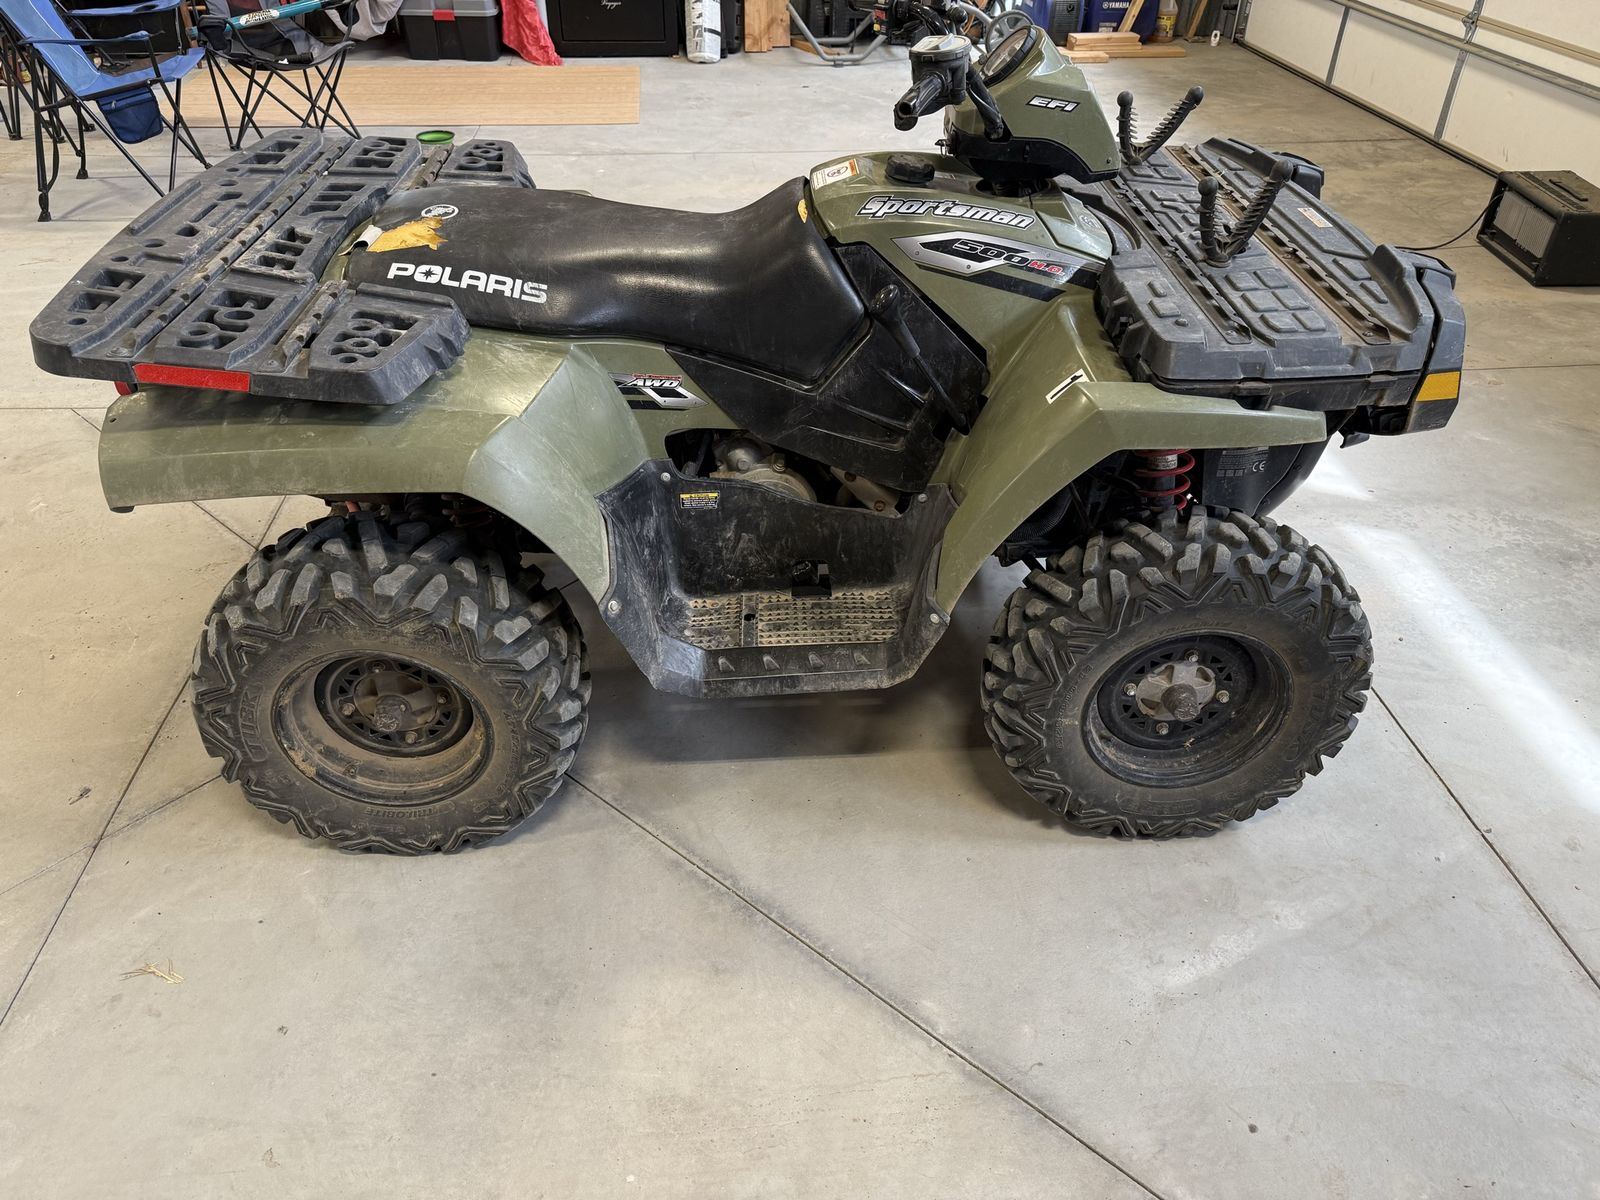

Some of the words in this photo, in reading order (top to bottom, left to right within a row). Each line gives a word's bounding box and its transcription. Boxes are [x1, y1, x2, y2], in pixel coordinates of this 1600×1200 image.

[1029, 96, 1078, 112] EFI
[858, 194, 1036, 229] Sportsman
[953, 239, 1031, 266] 500
[386, 262, 548, 304] POLARIS
[628, 378, 679, 388] AWD
